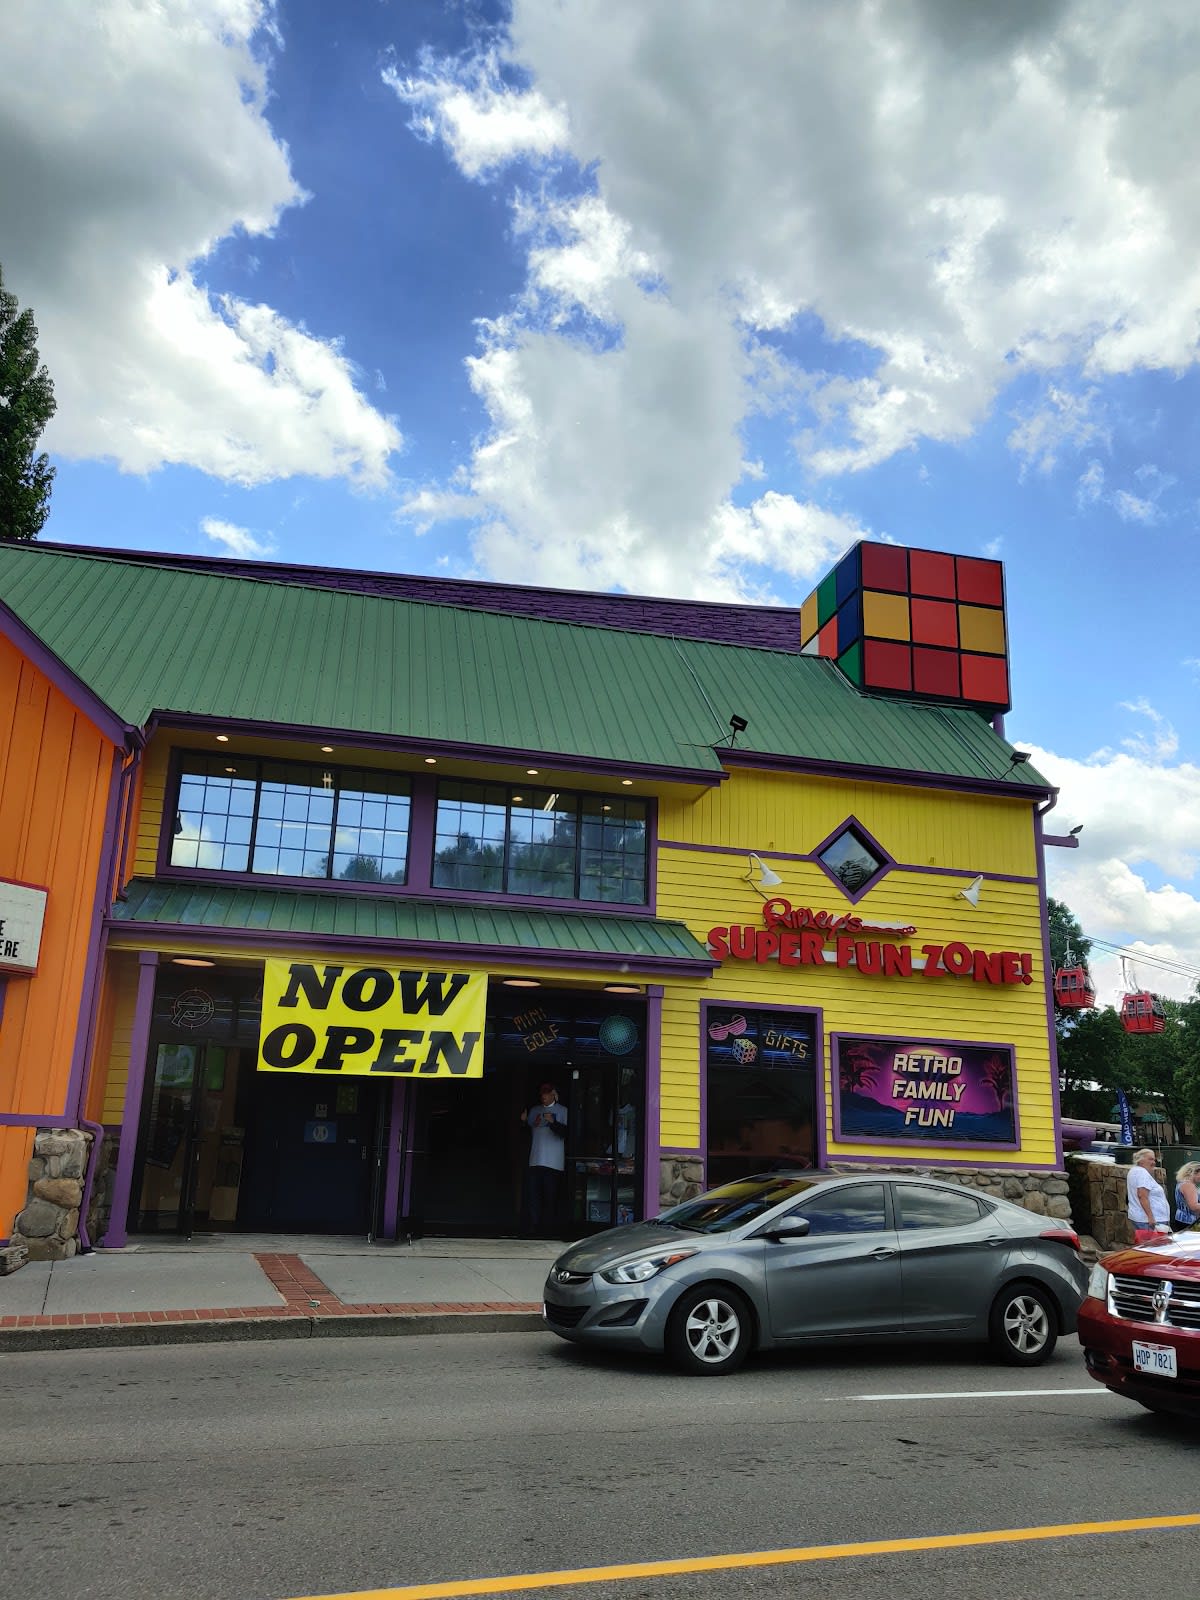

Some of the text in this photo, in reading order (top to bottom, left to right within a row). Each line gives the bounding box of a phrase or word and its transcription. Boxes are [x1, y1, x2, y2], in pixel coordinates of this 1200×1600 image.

[762, 898, 917, 940] Ripley's
[706, 925, 1034, 986] SUPER FUN ZONE!
[278, 963, 470, 1016] NOW
[512, 1008, 547, 1031] MINI
[262, 1023, 481, 1074] OPEN
[523, 1024, 560, 1052] GOLF
[764, 1030, 808, 1059] GIFTS
[892, 1053, 963, 1075] RETRO
[892, 1079, 967, 1102] FAMILY
[904, 1107, 955, 1128] FUN!
[1152, 1351, 1173, 1370] 7821
